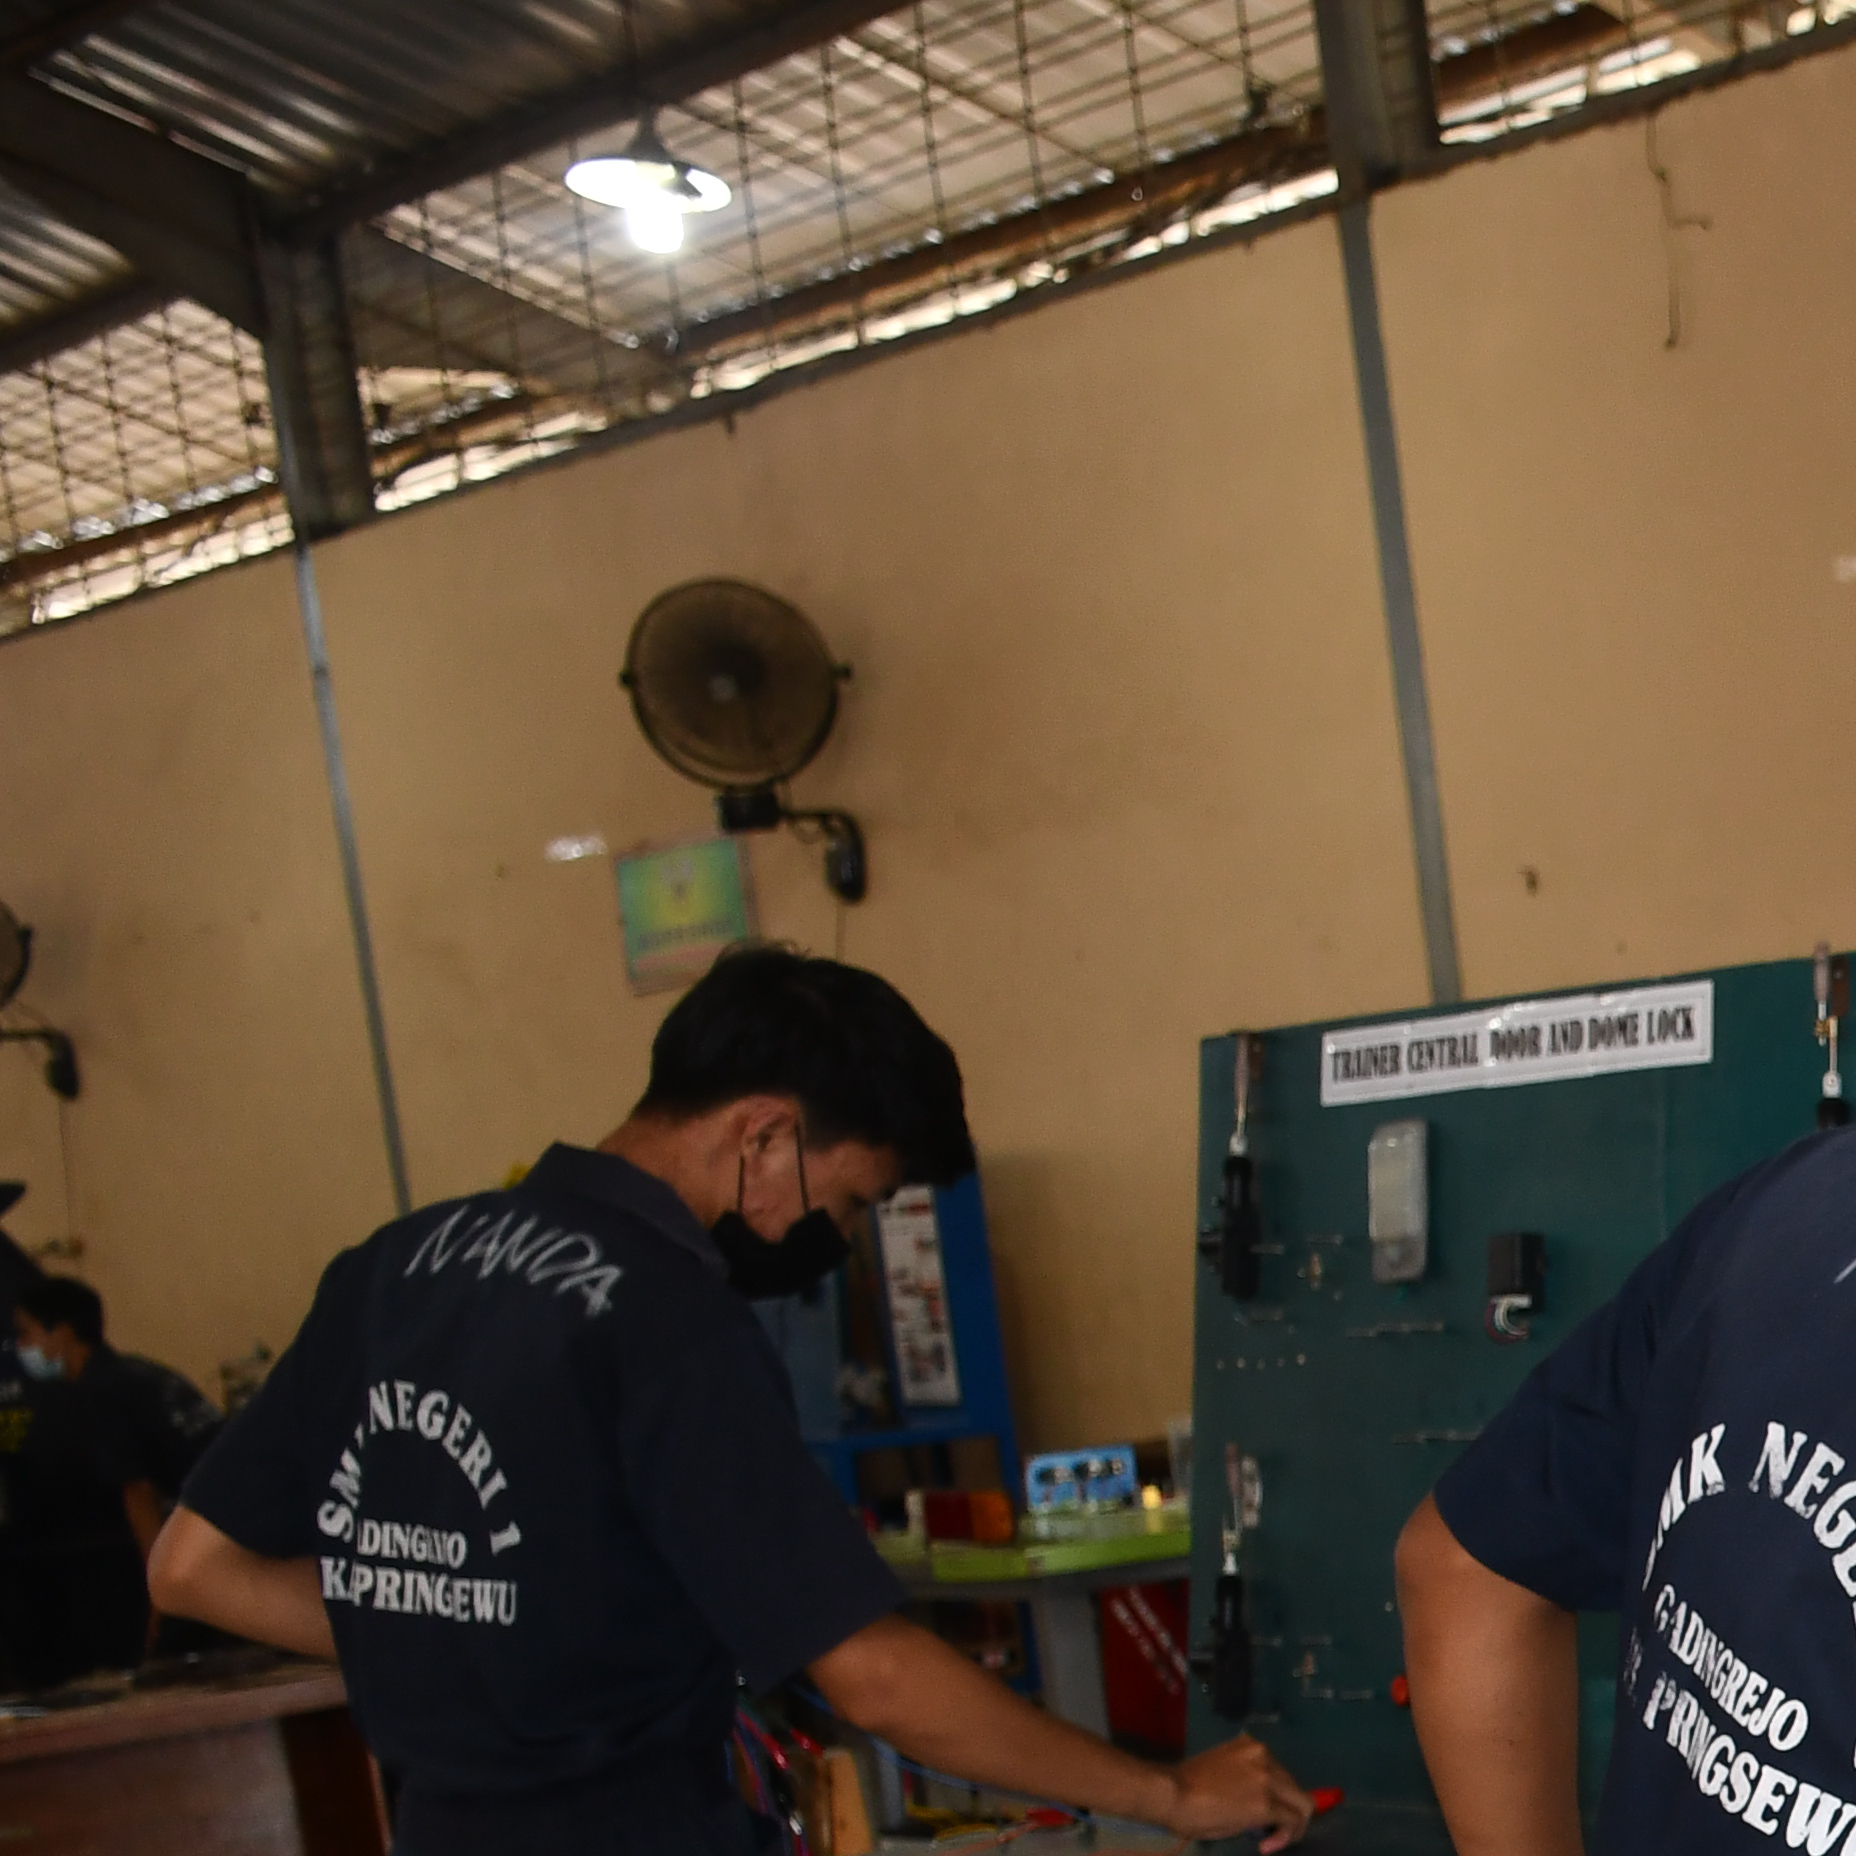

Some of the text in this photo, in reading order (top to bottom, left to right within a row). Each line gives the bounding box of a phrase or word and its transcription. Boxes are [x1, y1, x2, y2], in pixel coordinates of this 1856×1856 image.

[1331, 1004, 1696, 1083] TRAINER CENTRAL DOOR AND DOME LOCK
[368, 1378, 508, 1511] NEGERI
[489, 1520, 522, 1556] 1
[1653, 1583, 1809, 1752] GADINGREJO
